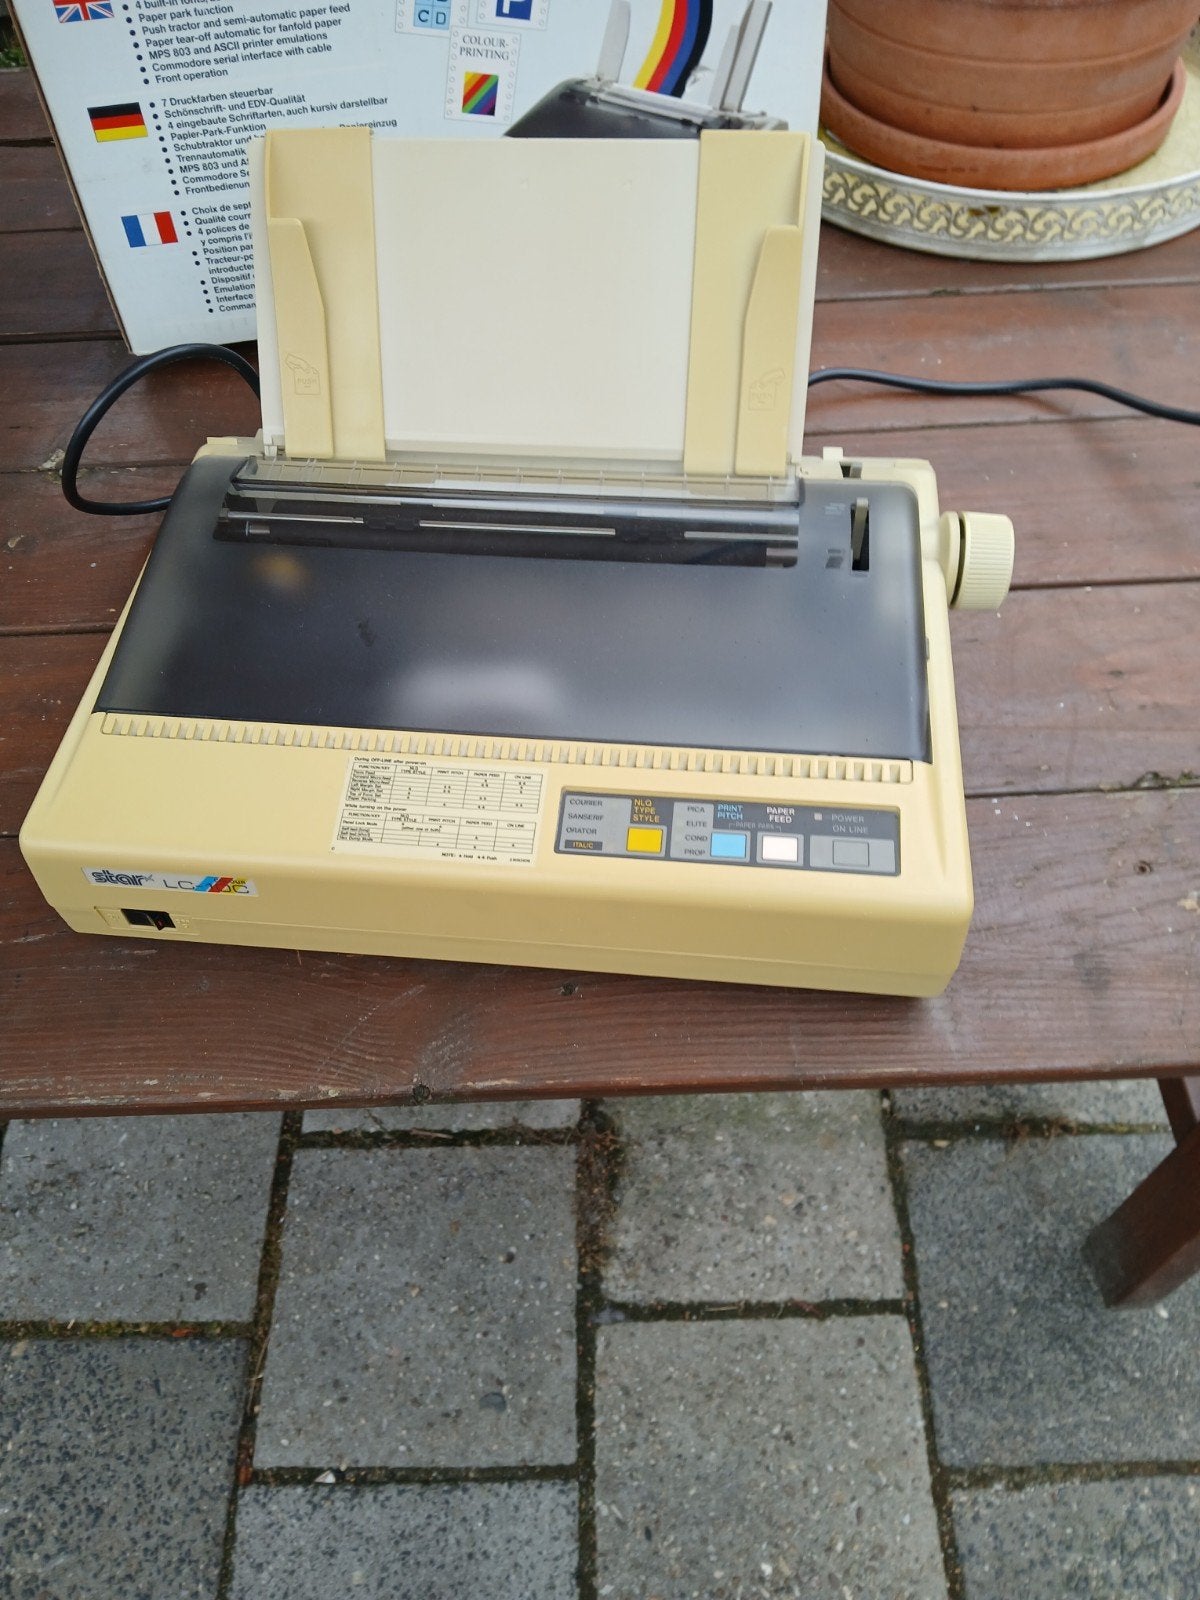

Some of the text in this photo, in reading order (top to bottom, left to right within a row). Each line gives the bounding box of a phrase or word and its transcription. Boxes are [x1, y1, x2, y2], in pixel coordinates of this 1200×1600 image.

[135, 1, 142, 9] 4
[144, 0, 178, 9] built-in
[138, 5, 234, 23] Paper park function
[142, 3, 351, 35] Push tractor and semi-automatic paper feed
[418, 9, 446, 25] C D
[145, 18, 342, 48] Paper tear-off automatic for fanfold paper
[149, 32, 328, 60] MPS 803 and ASCII printer emulations
[462, 34, 509, 48] COLOUR-
[152, 43, 332, 71] Commodore serial interface with cable
[460, 47, 509, 60] PRINTING
[155, 69, 229, 83] Front operation
[161, 88, 273, 107] 7 Druckfarben steuerbar
[164, 94, 306, 118] Schönschrift- und EDV-Qualität
[168, 97, 388, 130] 4 eingebaute Schriftarten, auch kursiv darstellbar
[171, 123, 267, 141] Papier-Park-Funktion
[173, 138, 232, 151] Schubtraktor
[176, 148, 247, 162] Trennautomatik
[179, 163, 201, 174] MPS
[202, 162, 219, 171] 803
[221, 159, 239, 169] und
[182, 171, 238, 184] Commodore
[191, 205, 217, 215] Choix
[220, 204, 231, 212] de
[194, 214, 226, 225] Qualité
[205, 226, 237, 236] polices
[208, 234, 243, 245] compris
[203, 246, 238, 255] Position
[211, 273, 251, 284] Dispositif
[214, 283, 255, 293] Emulation
[216, 293, 253, 303] Interface
[569, 799, 602, 807] COURIER
[634, 799, 652, 807] NLQ
[717, 804, 743, 812] PRINT
[635, 807, 656, 815] TYPE
[717, 812, 743, 820] PITCH
[766, 806, 795, 816] PAPER
[568, 813, 604, 821] SANSERIF
[632, 814, 660, 823] STYLE
[770, 814, 792, 823] FEED
[831, 814, 864, 822] POWER
[566, 827, 597, 835] ORATOR
[832, 825, 868, 834] ON LINE
[685, 834, 708, 842] COND
[573, 841, 593, 849] ITALIC
